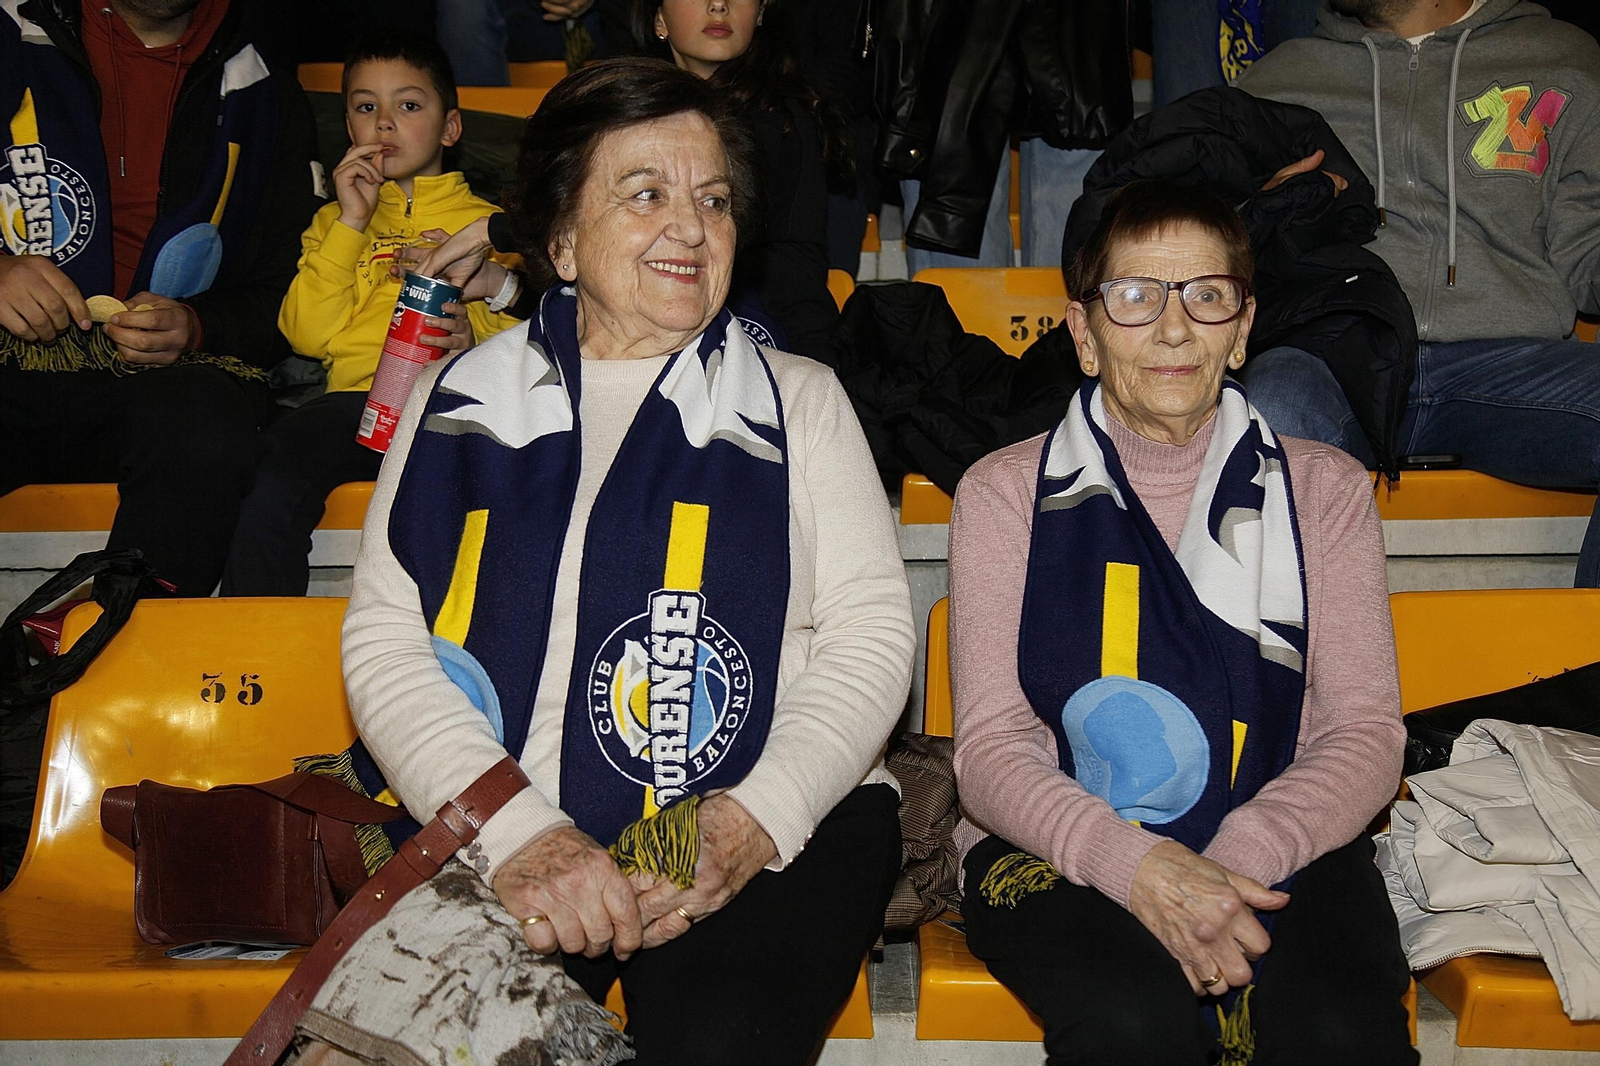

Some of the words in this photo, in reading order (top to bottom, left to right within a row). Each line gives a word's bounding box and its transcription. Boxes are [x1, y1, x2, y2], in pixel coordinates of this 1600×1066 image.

[8, 146, 53, 257] RENSE
[50, 163, 92, 261] BALONCESTO
[409, 287, 432, 303] WIN
[1010, 315, 1054, 341] 38
[200, 671, 264, 706] 35
[595, 660, 613, 736] CLUB
[693, 626, 748, 773] BALONCESTO
